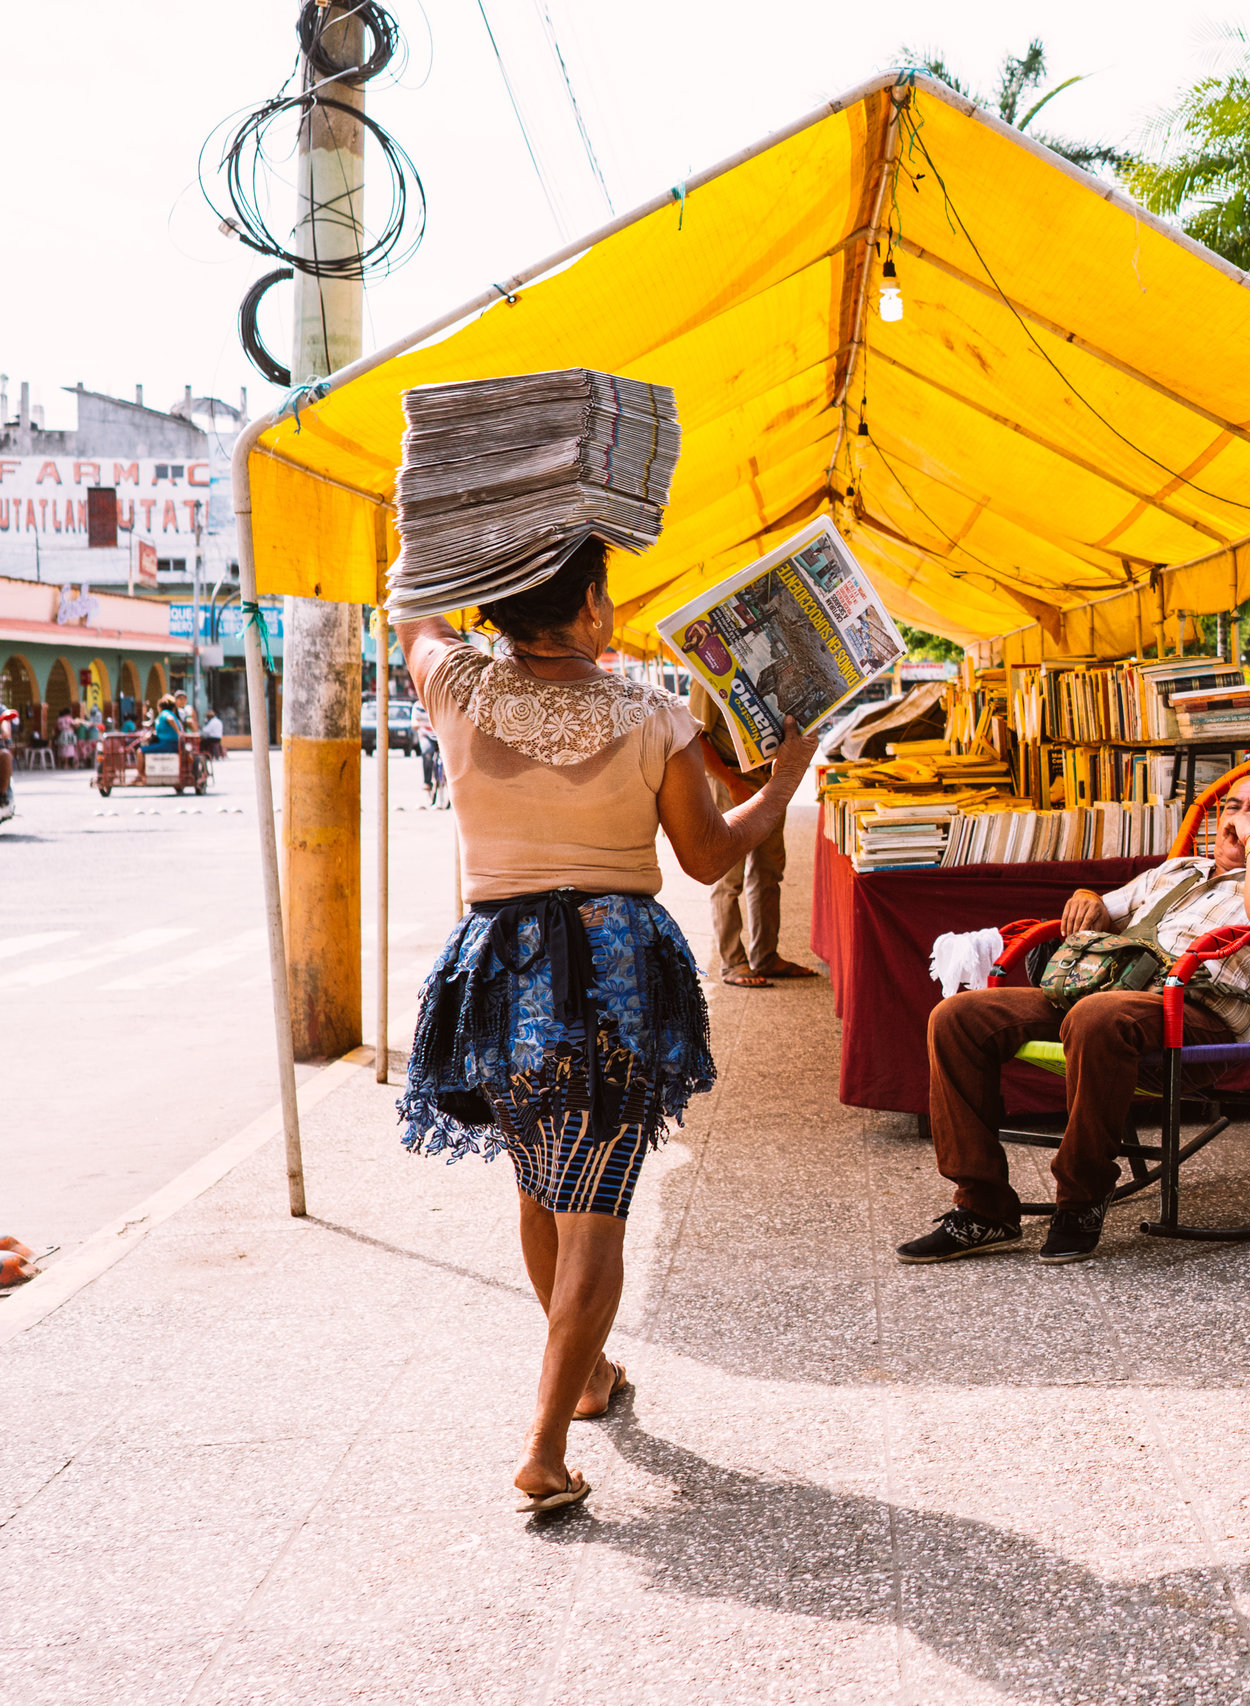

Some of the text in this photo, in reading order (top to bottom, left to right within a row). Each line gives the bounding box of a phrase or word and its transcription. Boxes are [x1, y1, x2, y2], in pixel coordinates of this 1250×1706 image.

[775, 563, 835, 639] SUROCCIDENTE
[825, 598, 844, 623] CAPTURAN
[830, 594, 847, 616] SICARIOS
[825, 634, 841, 653] EN
[834, 648, 860, 686] DAÑOS
[731, 679, 779, 757] Diario
[733, 697, 762, 742] Nuestro
